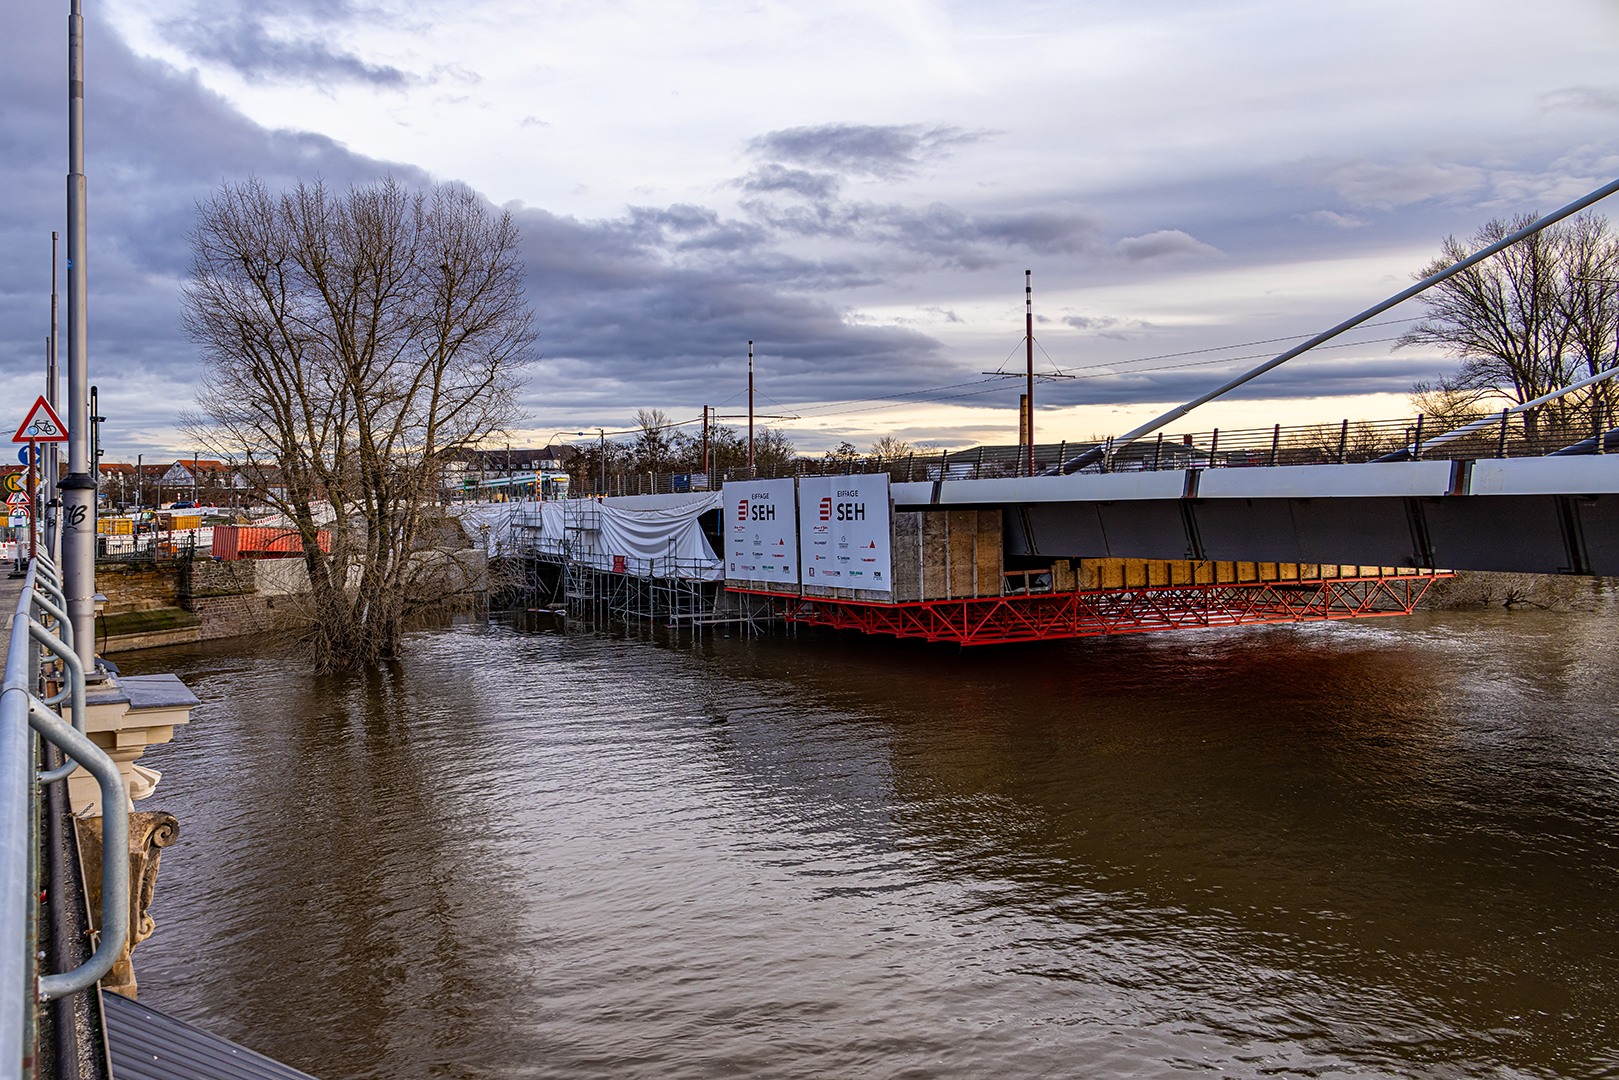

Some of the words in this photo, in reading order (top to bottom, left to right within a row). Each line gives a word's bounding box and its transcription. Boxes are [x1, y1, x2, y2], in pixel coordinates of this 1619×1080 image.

[751, 492, 770, 500] EIFFAGE
[837, 489, 859, 498] EIFFAGE
[751, 504, 775, 521] SEH
[836, 502, 865, 521] SEH
